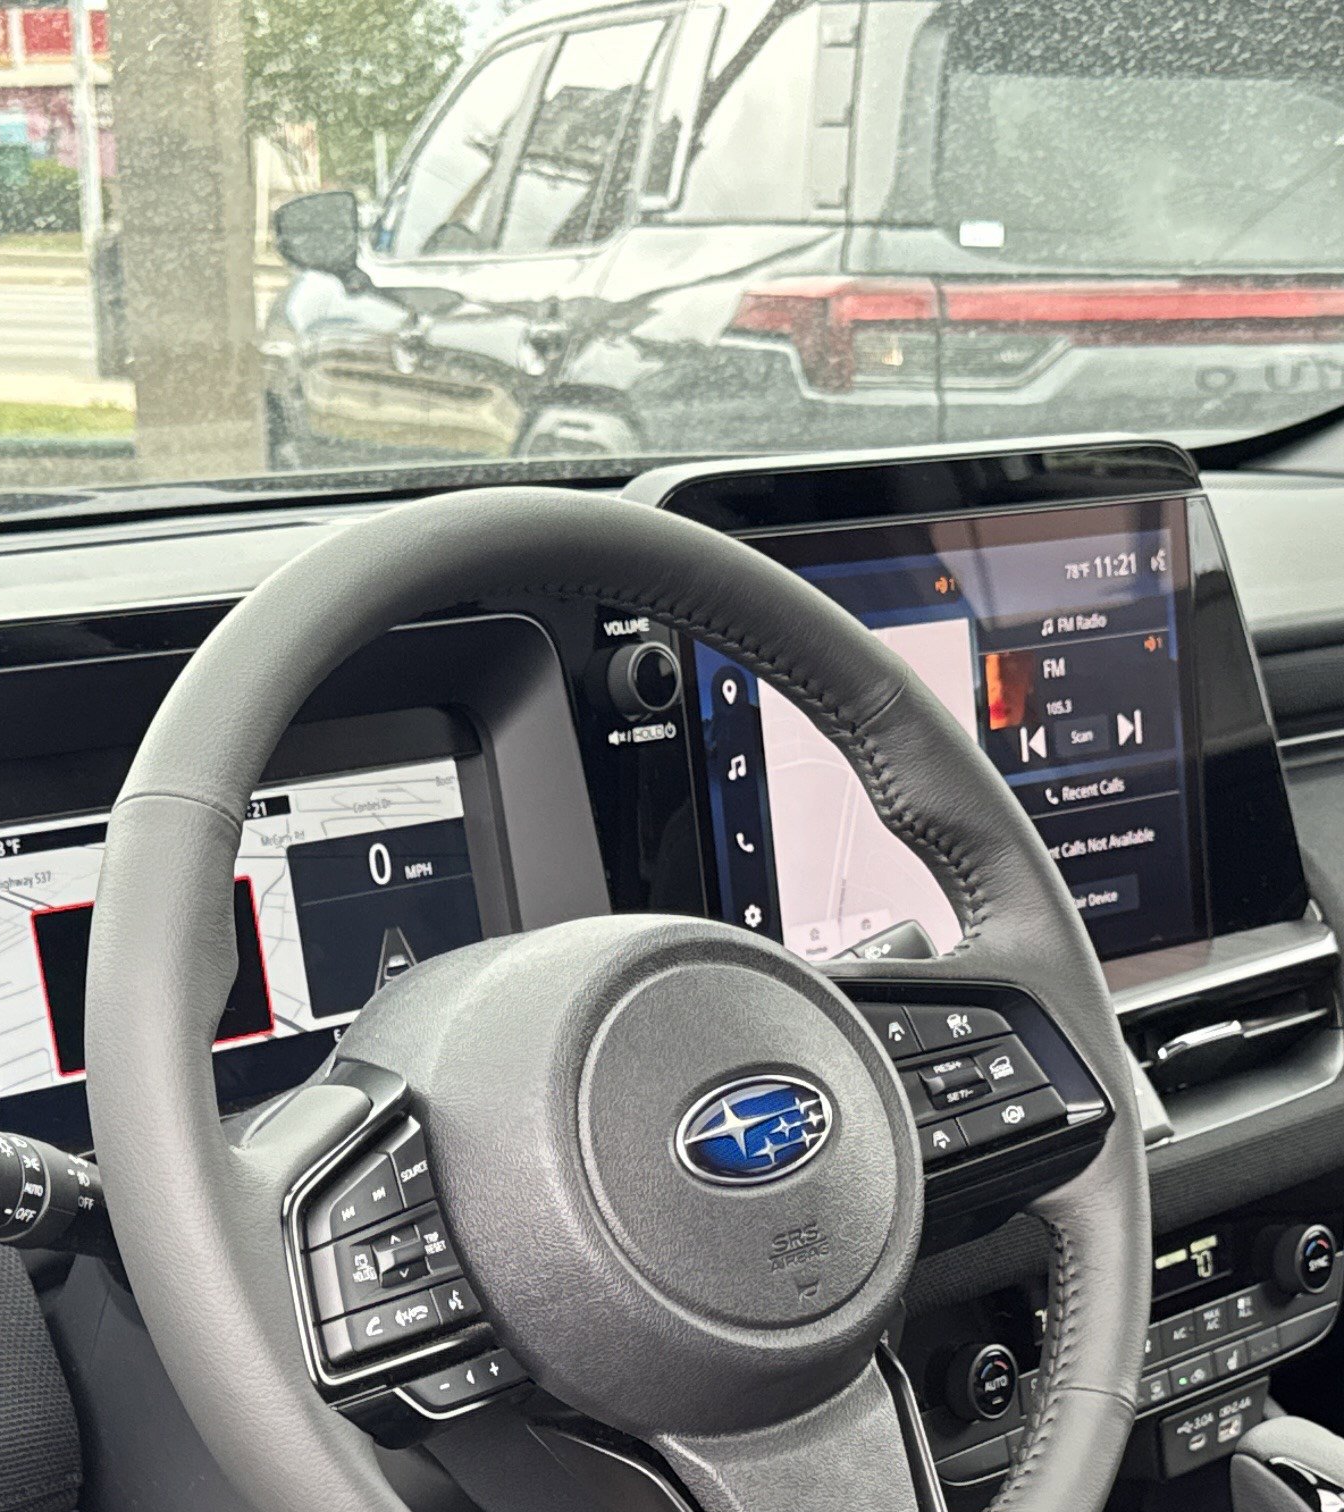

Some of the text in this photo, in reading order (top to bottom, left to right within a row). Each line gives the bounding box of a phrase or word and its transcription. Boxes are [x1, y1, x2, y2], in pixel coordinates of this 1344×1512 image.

[1094, 552, 1137, 579] 11:21
[603, 617, 650, 636] VOLUME
[1057, 613, 1107, 633] FM Radio
[1042, 656, 1066, 680] FM
[1061, 776, 1126, 802] Recent Calls
[1060, 840, 1087, 858] Calls
[1087, 836, 1108, 852] Not
[1108, 826, 1155, 849] Available
[368, 842, 392, 886] 0
[404, 861, 433, 880] MPH
[400, 1159, 429, 1183] SOURCE
[77, 1196, 94, 1211] OFF
[14, 1208, 37, 1223] OFF
[424, 1240, 447, 1255] RESET
[772, 1222, 819, 1252] SRS
[984, 1374, 1009, 1393] AUTO
